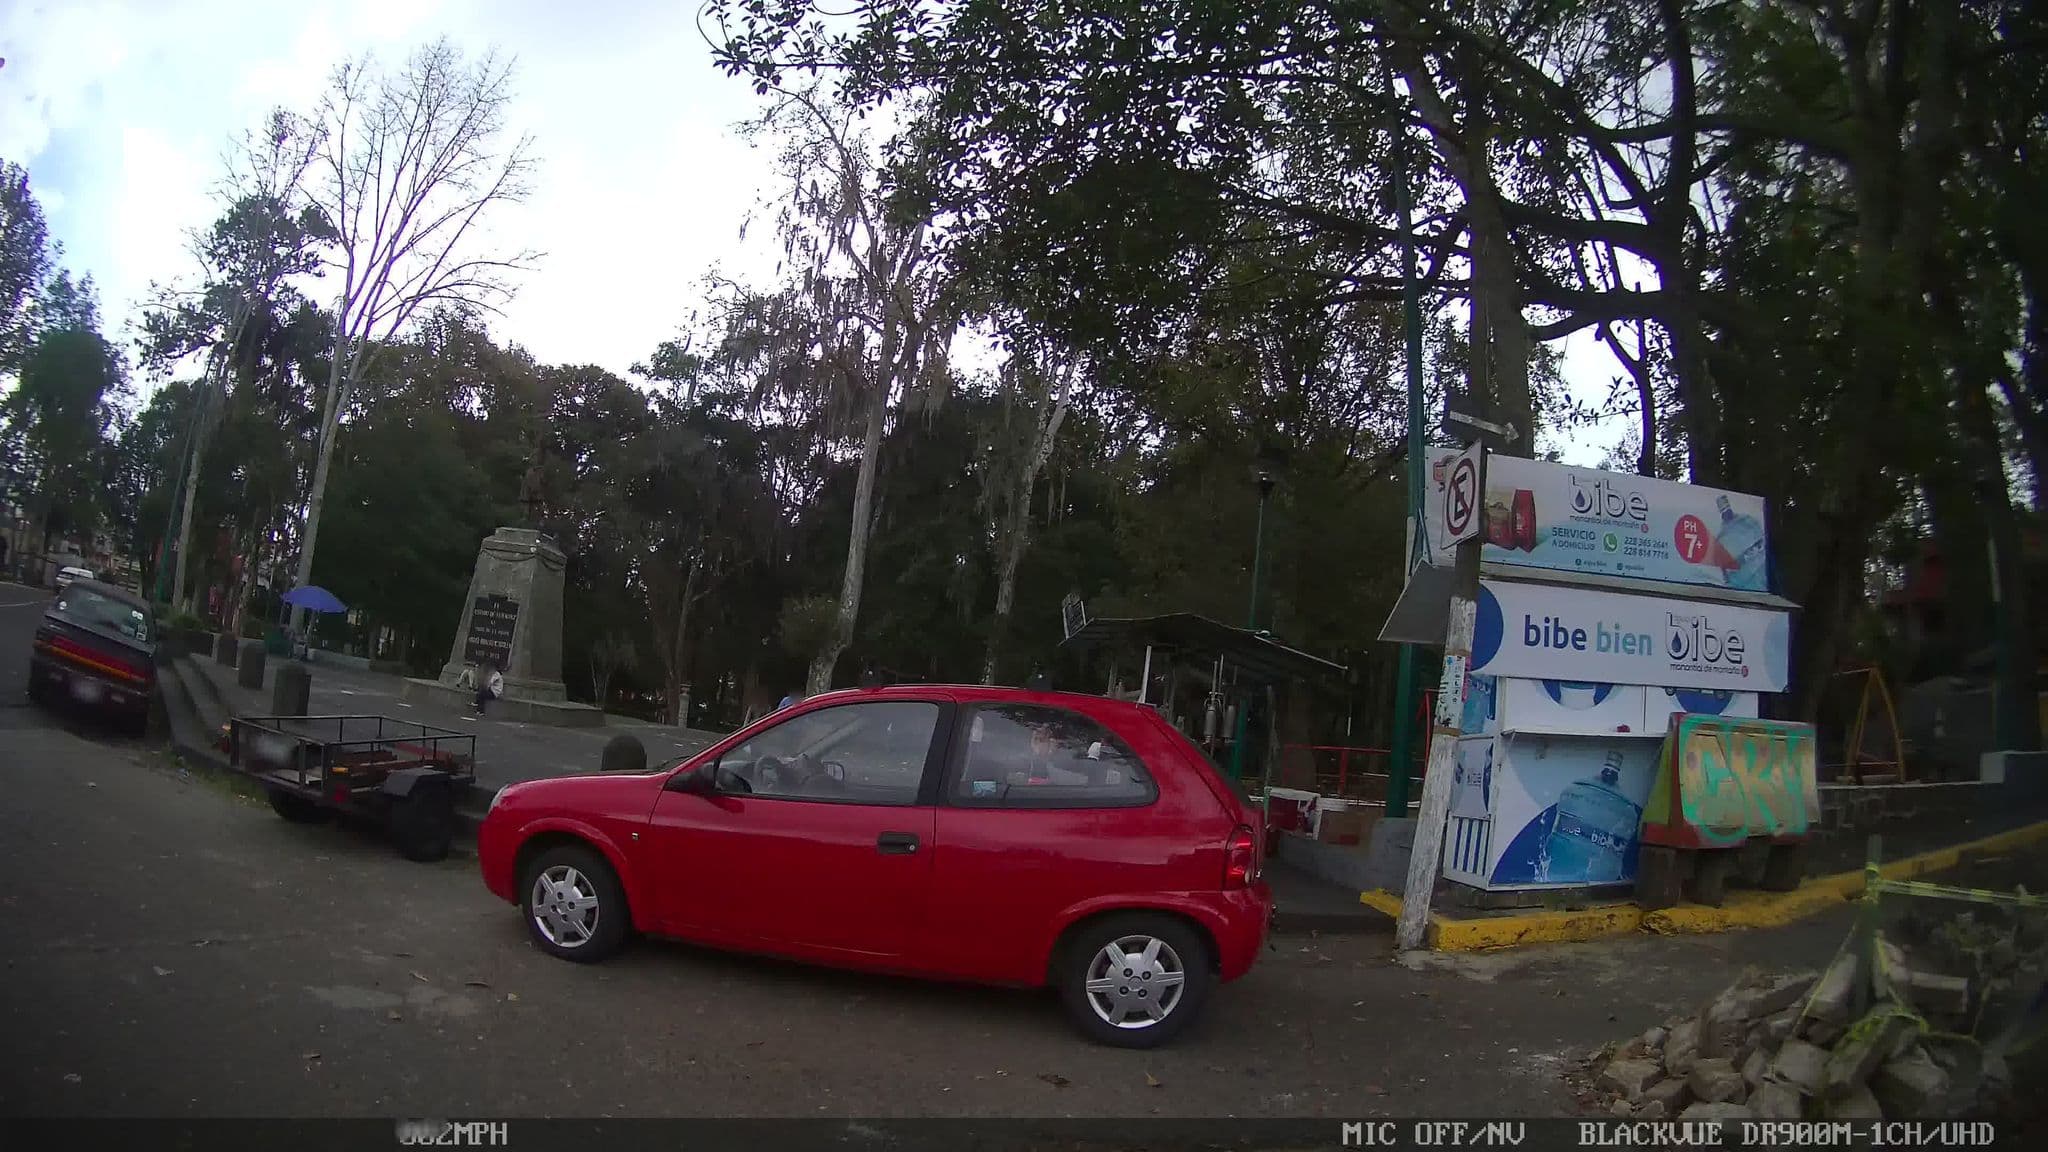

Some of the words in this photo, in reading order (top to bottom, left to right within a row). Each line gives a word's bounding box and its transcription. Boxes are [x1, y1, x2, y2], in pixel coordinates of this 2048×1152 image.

[1567, 474, 1648, 521] bibe
[1683, 520, 1697, 533] PH
[1552, 527, 1596, 540] SERVICIO
[1552, 539, 1558, 547] A
[1559, 540, 1596, 551] DOMICILIO
[1624, 546, 1638, 556] 228
[1524, 614, 1587, 651] bibe
[1596, 621, 1653, 656] bien
[1665, 610, 1744, 665] bibe
